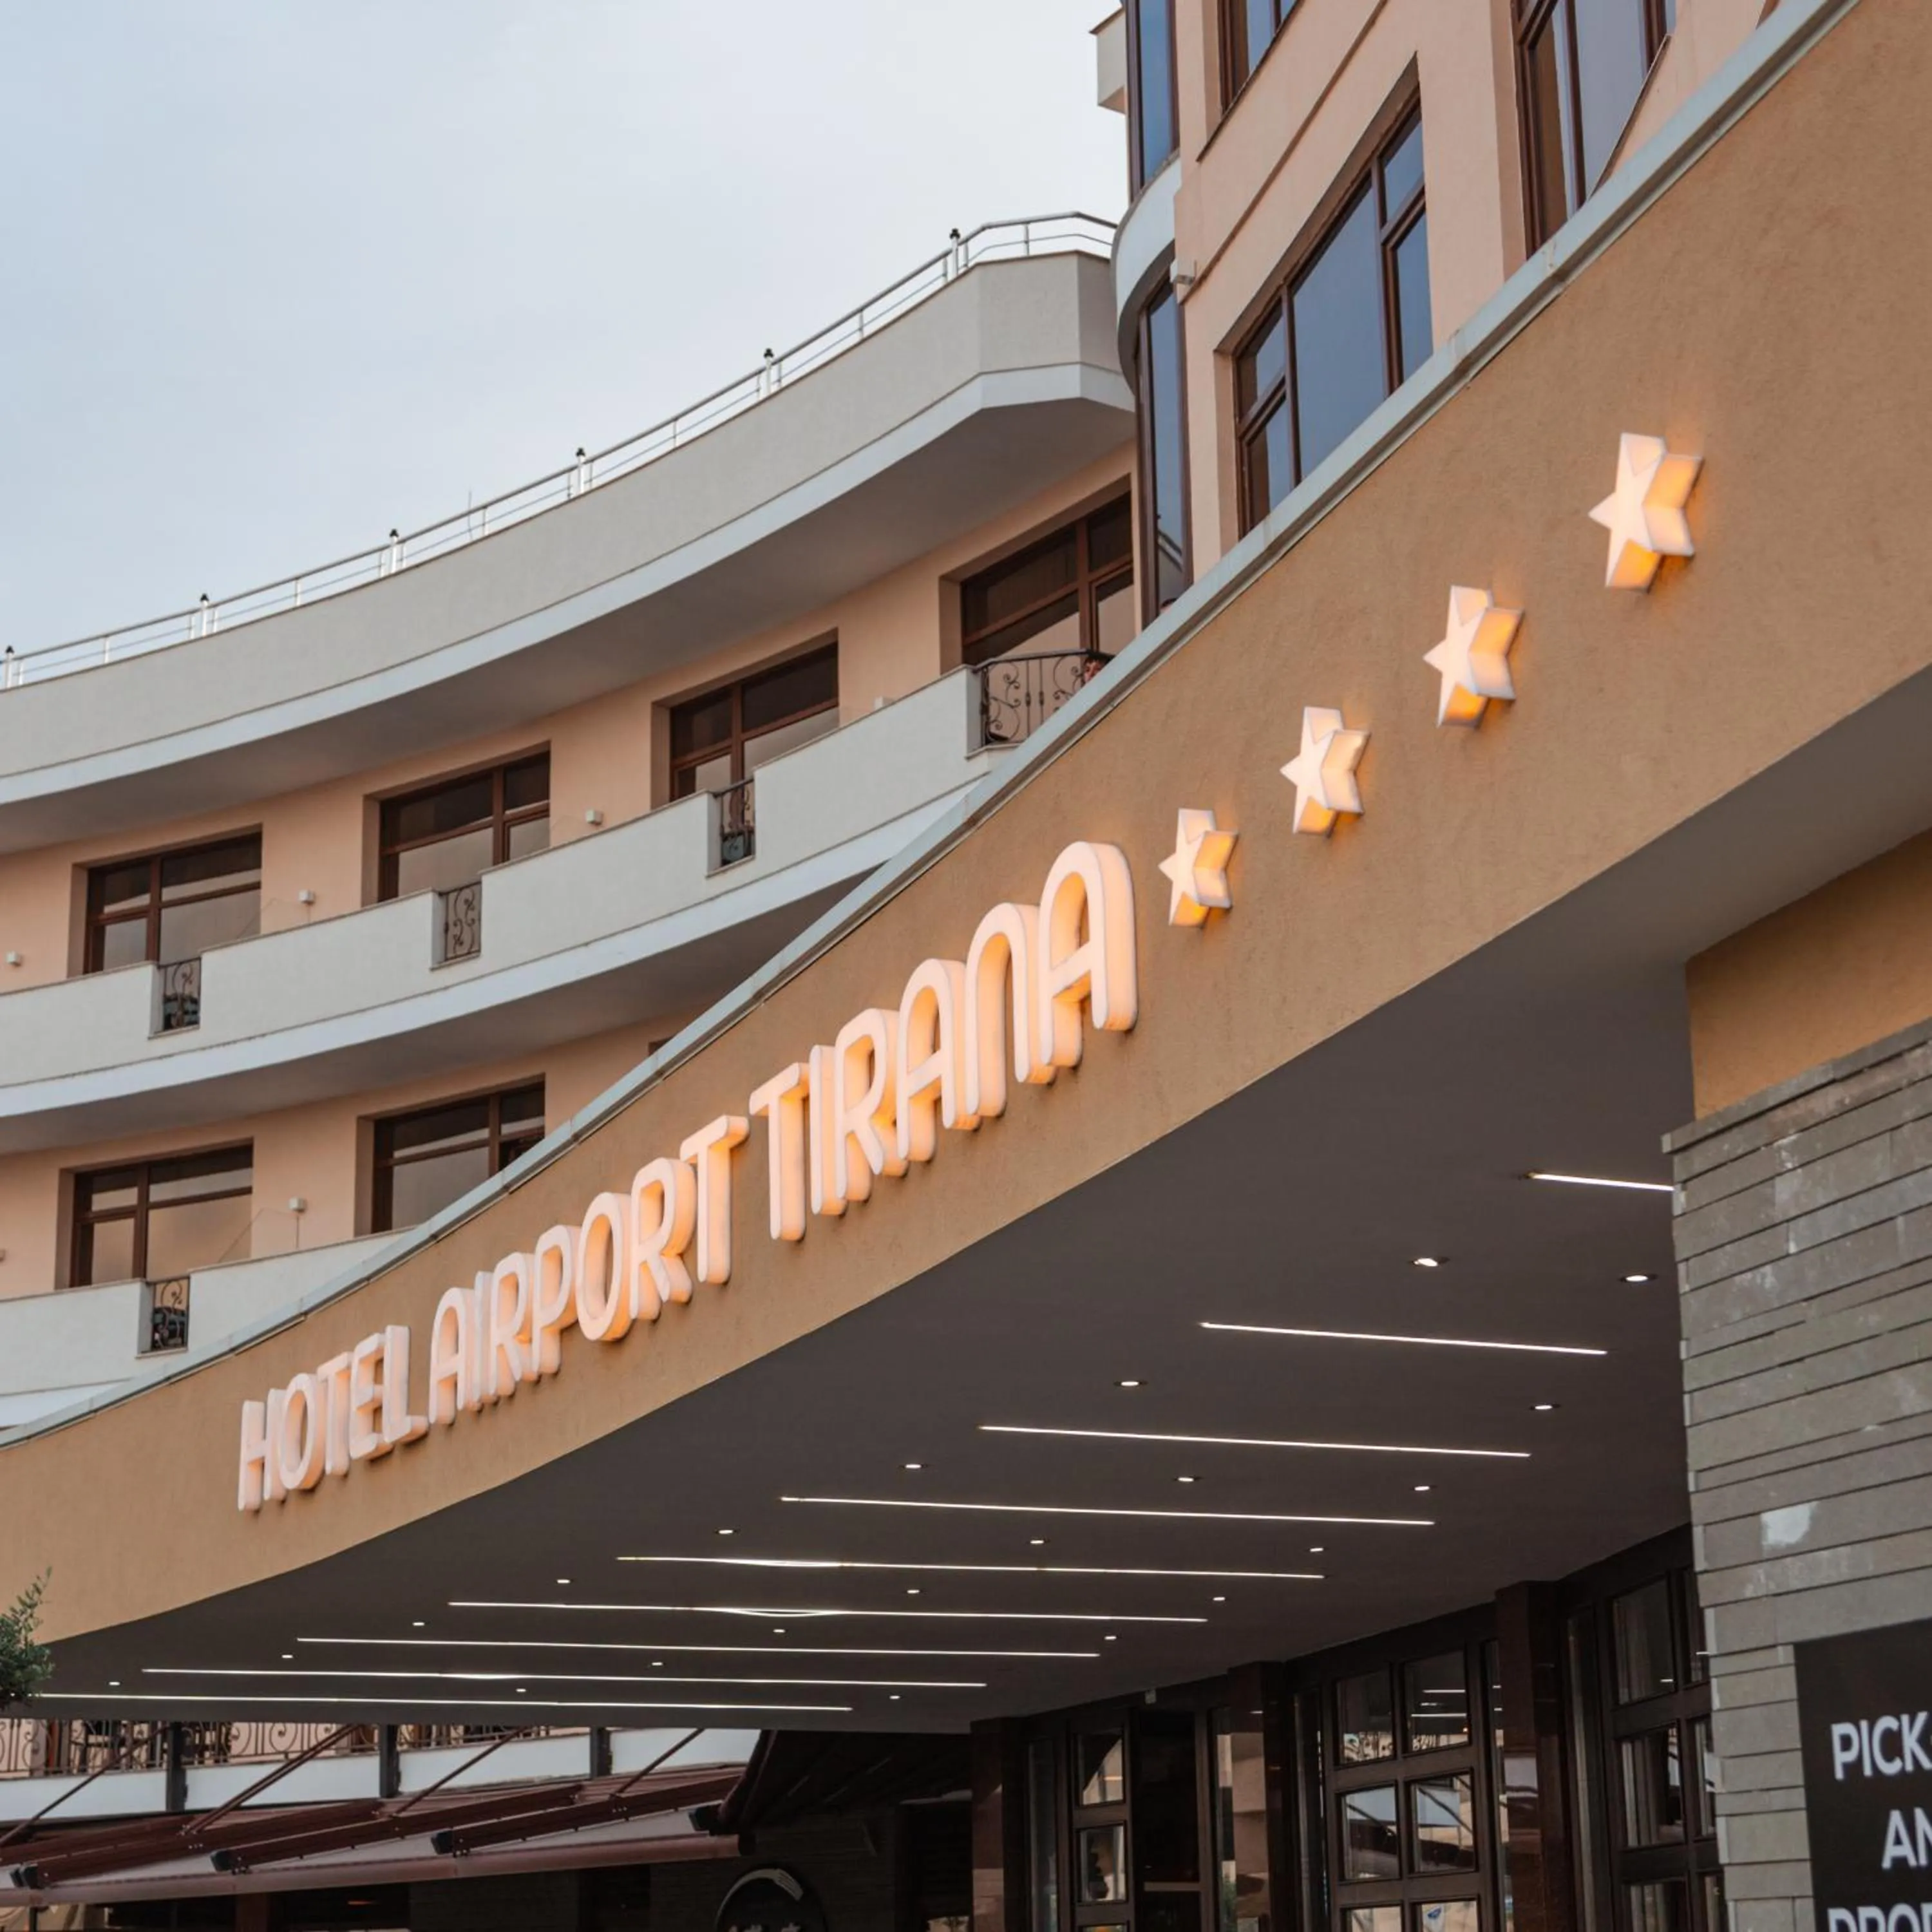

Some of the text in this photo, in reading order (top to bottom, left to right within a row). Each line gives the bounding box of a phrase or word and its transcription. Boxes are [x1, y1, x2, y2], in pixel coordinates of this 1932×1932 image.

[238, 841, 1138, 1510] HOTEL AIRPORT TIRANA
[1830, 1710, 1932, 1781] PICK
